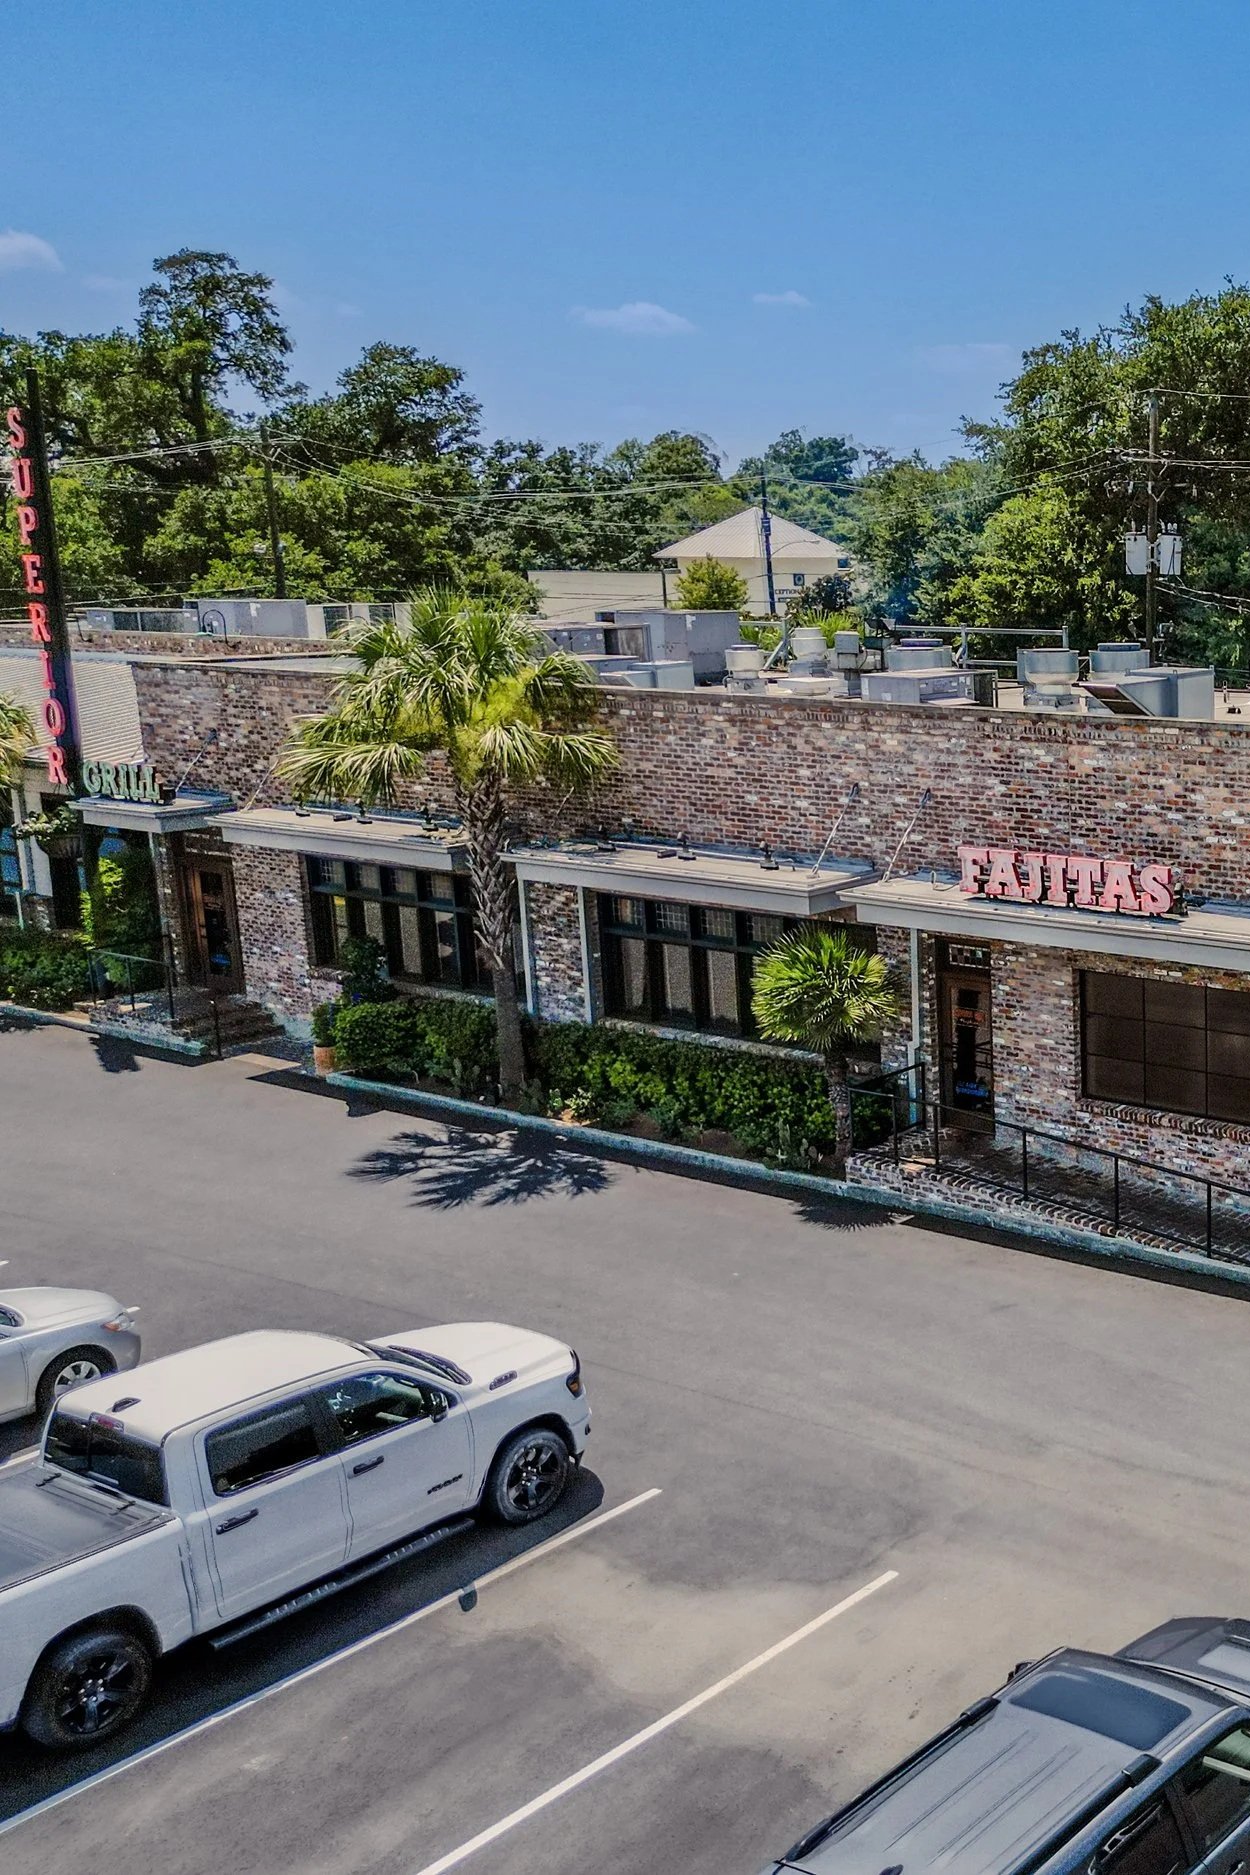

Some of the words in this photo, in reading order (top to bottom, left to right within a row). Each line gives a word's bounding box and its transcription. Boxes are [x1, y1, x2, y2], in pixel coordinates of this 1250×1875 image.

[7, 406, 68, 785] SUPERIOR
[83, 760, 160, 800] GRILL
[957, 846, 1174, 914] FAJITAS
